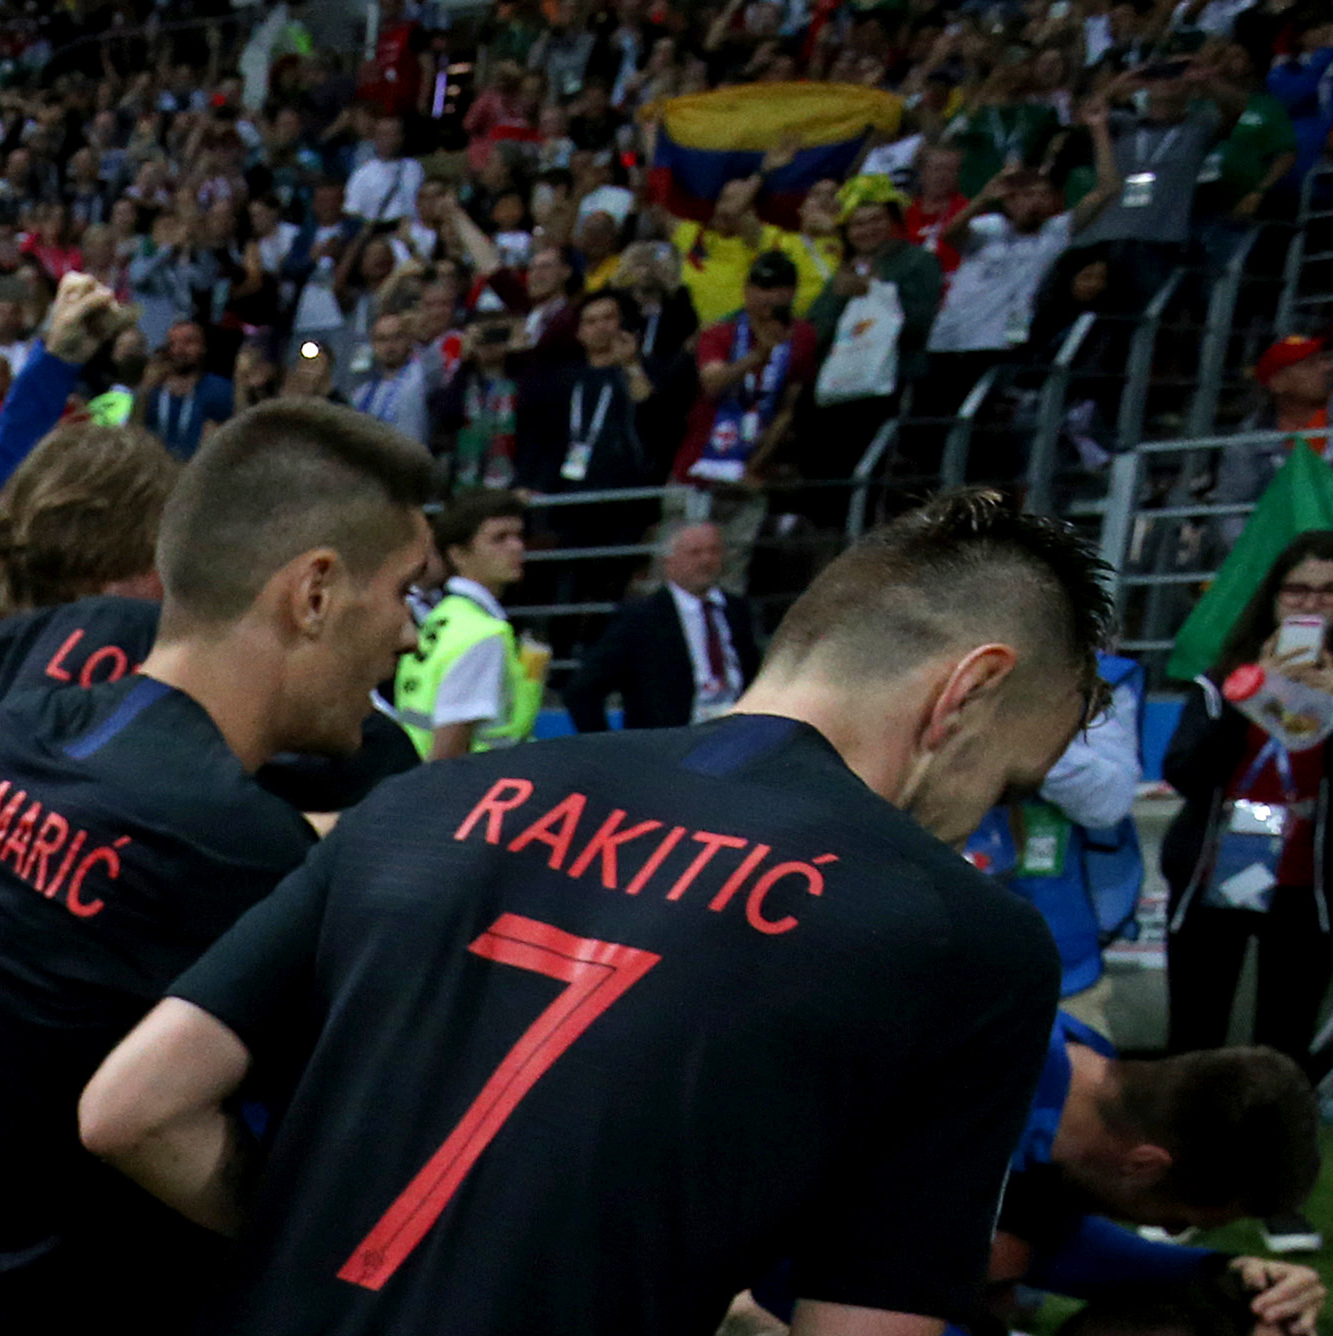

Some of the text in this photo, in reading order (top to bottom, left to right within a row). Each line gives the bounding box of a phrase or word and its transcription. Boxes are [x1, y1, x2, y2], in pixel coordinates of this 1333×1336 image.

[45, 628, 142, 690] LO
[453, 777, 840, 936] RAKITIĆ
[336, 912, 662, 1291] 7
